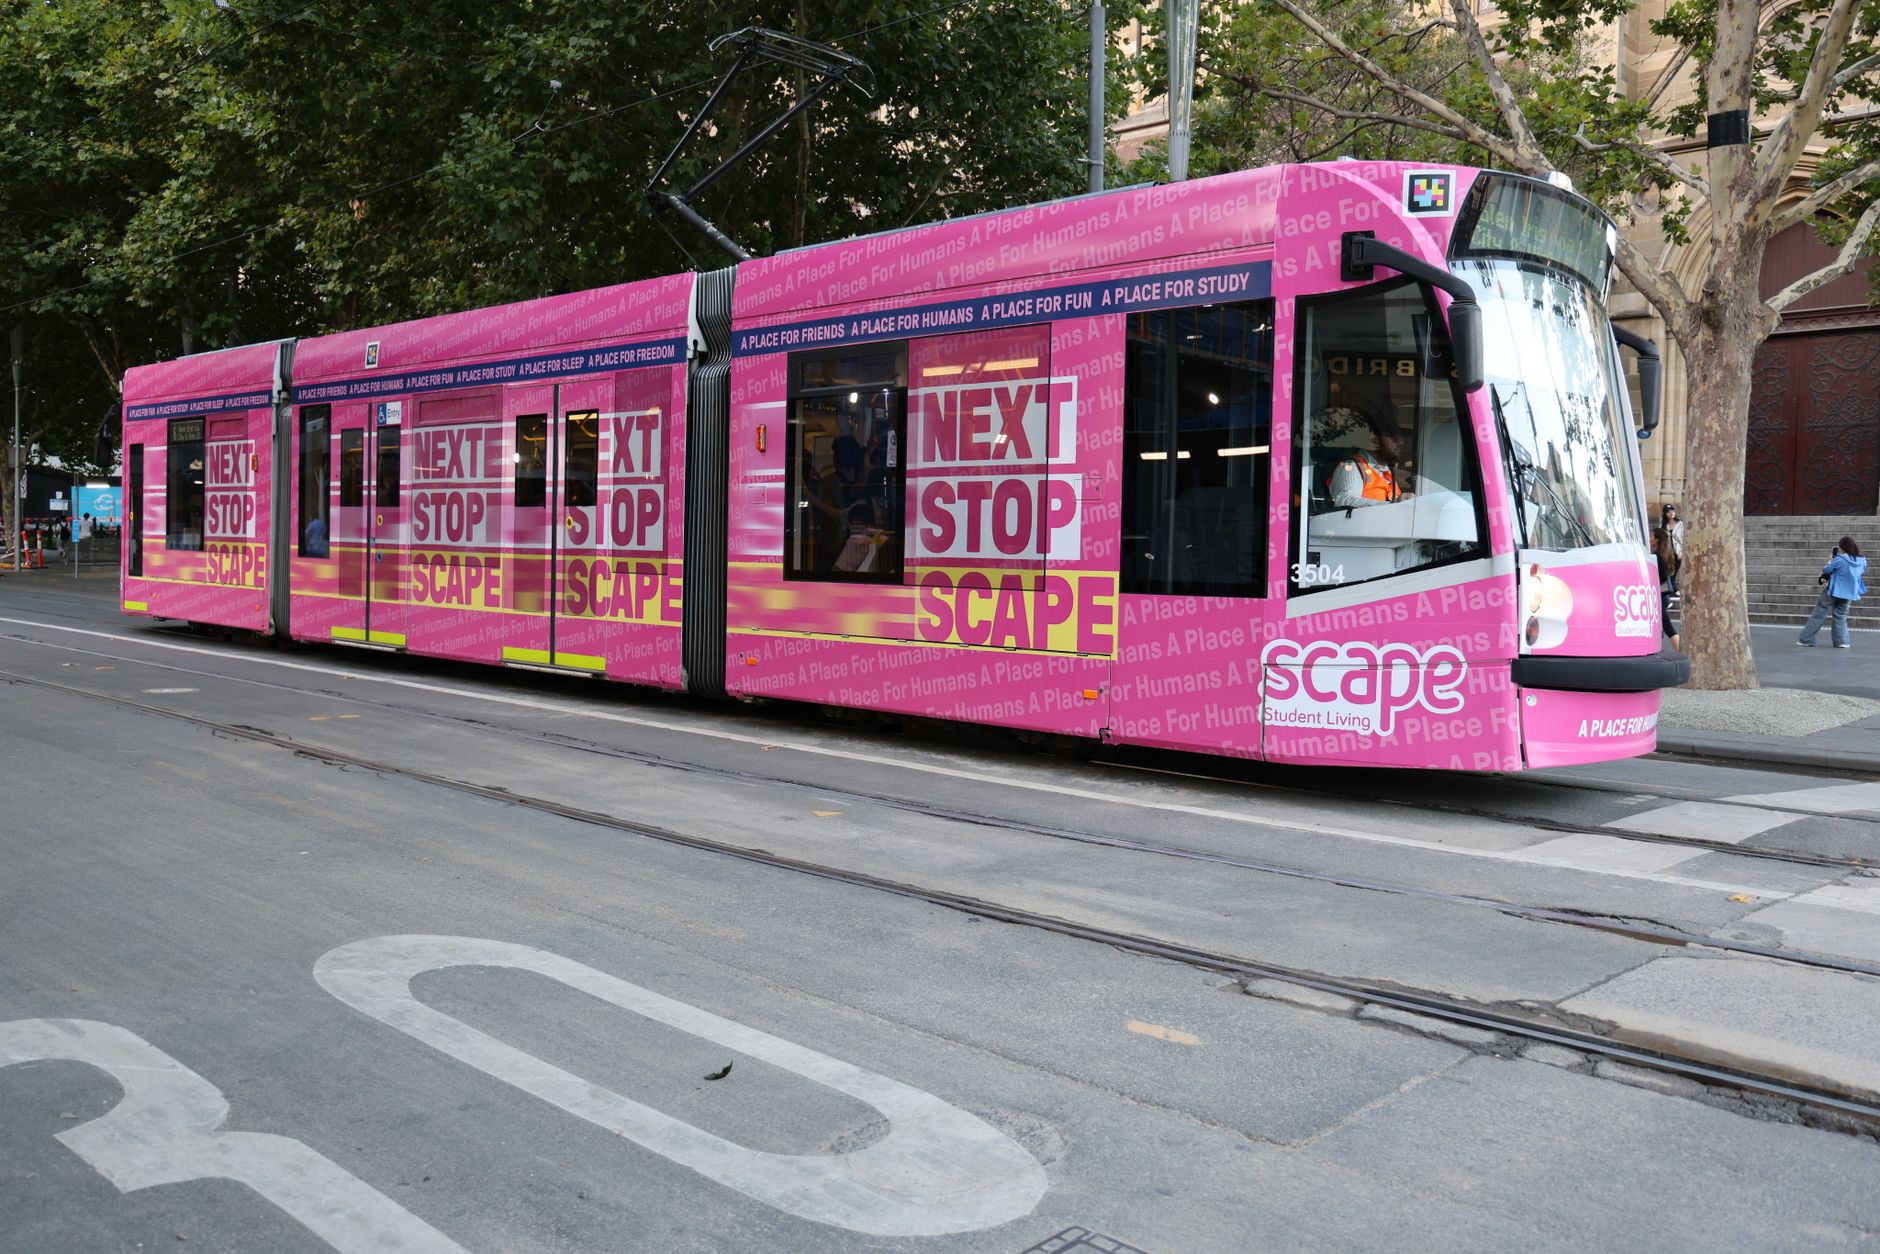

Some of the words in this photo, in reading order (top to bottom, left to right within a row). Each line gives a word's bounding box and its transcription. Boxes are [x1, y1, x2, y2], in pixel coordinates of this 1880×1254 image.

[986, 207, 1034, 241] Place
[1000, 242, 1029, 268] For
[1033, 211, 1110, 254] Humans
[1115, 201, 1128, 223] A
[1134, 182, 1190, 215] Place
[1082, 227, 1164, 269] Humans
[1169, 214, 1184, 237] A
[1188, 194, 1248, 229] Place
[1255, 177, 1294, 208] For
[1337, 198, 1386, 226] For
[785, 274, 795, 292] A
[800, 260, 835, 290] Place
[840, 247, 864, 269] For
[829, 275, 867, 304] Place
[872, 262, 895, 285] For
[900, 235, 966, 271] Humans
[970, 226, 982, 245] A
[1305, 251, 1322, 272] A
[1101, 290, 1111, 306] A
[1114, 283, 1162, 304] PLACE
[1165, 279, 1193, 299] FOR
[1198, 272, 1250, 295] STUDY
[480, 312, 504, 333] Place
[506, 304, 521, 318] For
[501, 324, 526, 345] Place
[528, 316, 544, 330] For
[545, 295, 586, 323] Humans
[557, 326, 573, 340] For
[575, 307, 616, 333] Humans
[619, 300, 626, 312] A
[629, 290, 658, 309] Place
[662, 277, 684, 294] For
[654, 299, 685, 323] Place
[851, 322, 859, 336] A
[861, 317, 895, 335] PLACE
[897, 314, 918, 330] FOR
[922, 307, 974, 327] HUMANS
[981, 305, 990, 320] A
[993, 299, 1032, 319] PLACE
[1036, 296, 1062, 314] FOR
[1065, 292, 1092, 310] FUN
[741, 337, 748, 350] A
[749, 333, 779, 349] PLACE
[780, 330, 799, 344] FOR
[802, 324, 845, 342] FRIENDS
[519, 365, 524, 374] A
[525, 362, 546, 374] PLACE
[547, 360, 561, 372] FOR
[562, 357, 584, 370] SLEEP
[588, 356, 594, 366] A
[594, 352, 618, 365] PLACE
[620, 350, 635, 363] FOR
[637, 345, 675, 361] FREEDOM
[350, 385, 353, 393] A
[354, 383, 370, 393] PLACE
[370, 382, 380, 391] FOR
[381, 379, 403, 390] HUMANS
[407, 379, 411, 387] A
[411, 376, 429, 387] PLACE
[430, 375, 441, 385] FOR
[441, 374, 453, 383] FUN
[457, 372, 462, 382] A
[462, 370, 481, 381] PLACE
[482, 368, 494, 379] FOR
[495, 366, 516, 377] STUDY
[747, 375, 767, 398] For
[303, 389, 316, 398] PLACE
[317, 388, 326, 397] FOR
[327, 386, 347, 396] FRIENDS
[387, 407, 400, 420] Entry
[923, 382, 1073, 462] NEXT
[414, 427, 484, 480] NEXT
[599, 415, 659, 474] EXT
[209, 443, 254, 484] NEXT
[209, 493, 255, 535] STOP
[413, 491, 484, 542] STOP
[567, 487, 661, 547] STOP
[920, 478, 1077, 554] STOP
[1082, 536, 1114, 560] For
[207, 543, 265, 588] SCAPE
[412, 553, 501, 608] SCAPE
[1290, 563, 1346, 584] 3504
[567, 558, 683, 622] SCAPE
[411, 623, 425, 638] For
[426, 614, 457, 633] Humans
[918, 571, 1115, 654] SCAPE
[1123, 602, 1137, 627] A
[1141, 597, 1197, 624] Place
[1167, 633, 1182, 656] A
[1185, 626, 1245, 655] Place
[1250, 616, 1289, 642] For
[1296, 602, 1409, 636] Humans
[1416, 591, 1435, 619] A
[1441, 584, 1517, 613] Place
[1614, 584, 1660, 637] scape
[447, 631, 478, 650] Humans
[486, 624, 510, 642] Place
[596, 621, 624, 640] Place
[615, 650, 623, 664] A
[624, 642, 653, 660] Place
[656, 634, 672, 651] For
[763, 644, 772, 661] A
[742, 668, 796, 693] Humans
[798, 665, 807, 683] A
[810, 656, 849, 679] Place
[851, 653, 876, 675] For
[879, 645, 941, 671] Humans
[883, 680, 908, 701] For
[911, 667, 977, 697] Humans
[980, 665, 993, 685] A
[995, 655, 1044, 682] Place
[1100, 679, 1132, 705] For
[1136, 665, 1221, 700] Humans
[1227, 661, 1242, 687] A
[1258, 638, 1468, 737] scape
[955, 696, 1025, 722] Humans
[1027, 693, 1040, 713] A
[1264, 707, 1322, 725] Student
[1326, 709, 1371, 730] Living
[1109, 712, 1162, 739] Place
[1166, 708, 1200, 733] For
[1404, 714, 1483, 745] Place
[1577, 719, 1588, 738] A
[1590, 718, 1628, 738] PLACE
[1626, 716, 1643, 735] FOR
[1264, 731, 1373, 759] Humans
